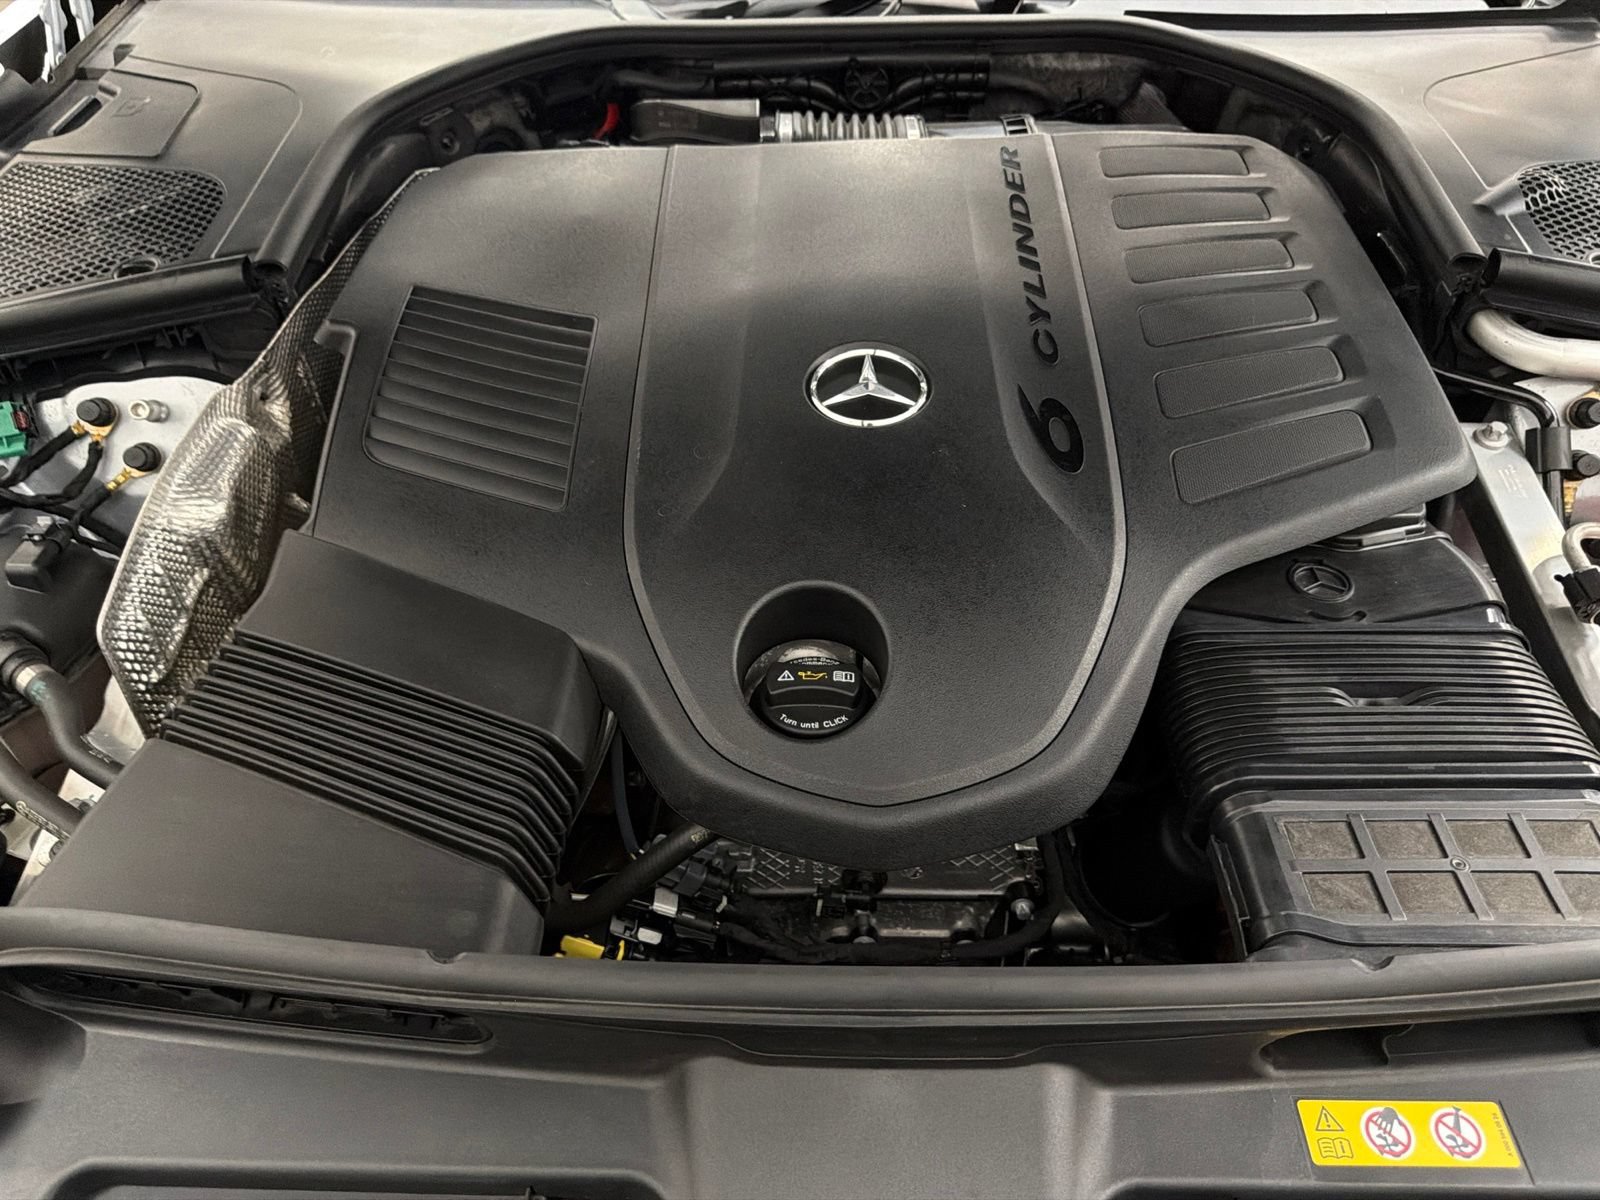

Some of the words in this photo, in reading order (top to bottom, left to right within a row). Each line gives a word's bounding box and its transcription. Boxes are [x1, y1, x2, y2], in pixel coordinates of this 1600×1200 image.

[1000, 145, 1060, 366] CYLINDER
[1017, 383, 1084, 473] 6
[779, 713, 797, 726] Turn
[823, 715, 848, 728] CLICK
